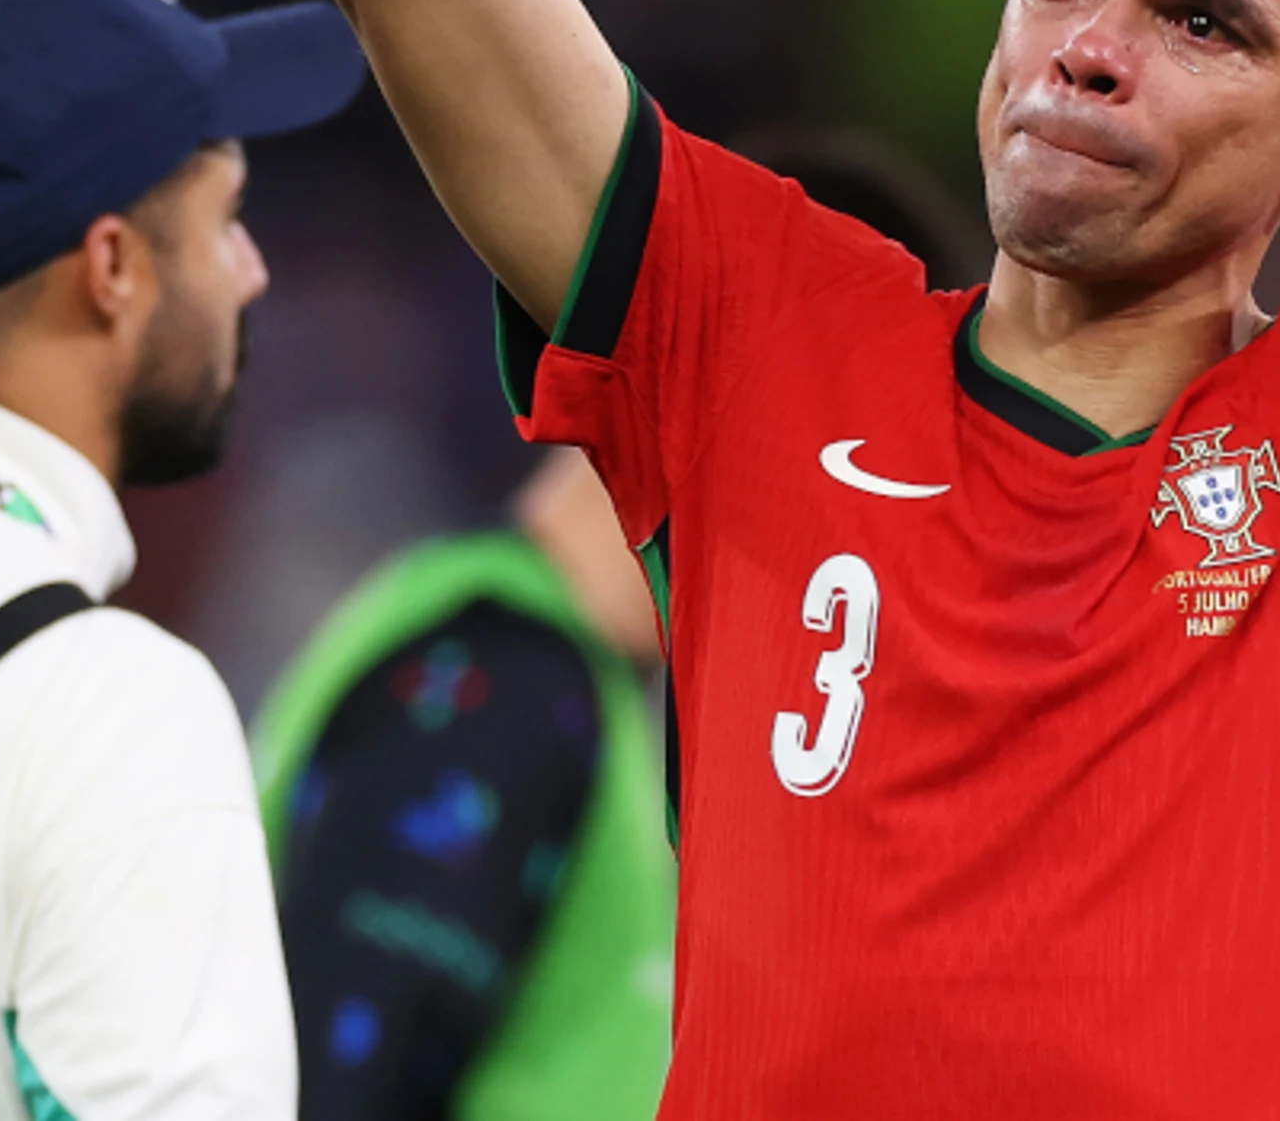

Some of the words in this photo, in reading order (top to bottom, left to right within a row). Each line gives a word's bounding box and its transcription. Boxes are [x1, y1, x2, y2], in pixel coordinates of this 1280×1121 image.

[1177, 592, 1189, 614] 5
[1192, 590, 1250, 613] JULHO
[771, 553, 880, 797] 3
